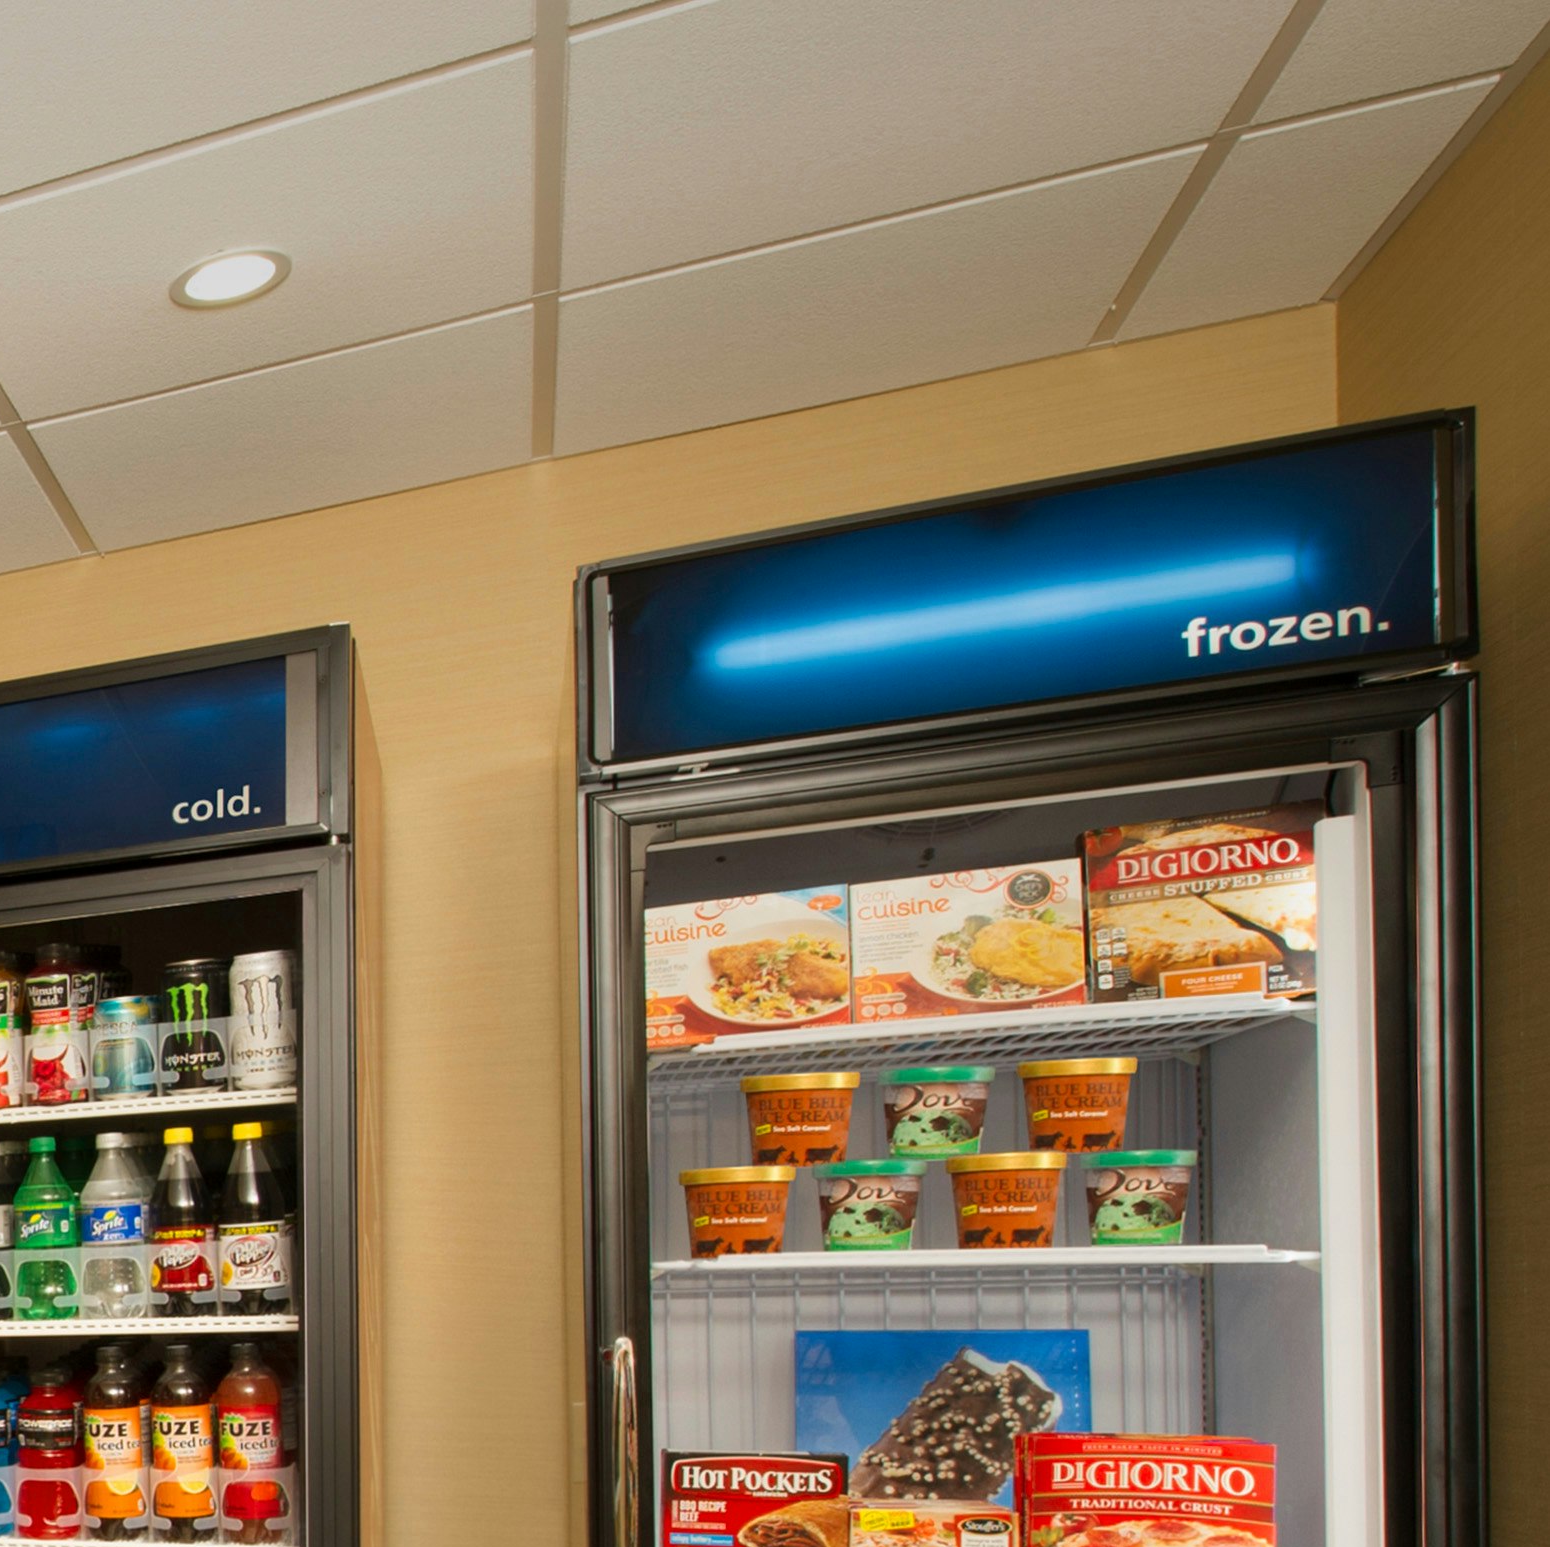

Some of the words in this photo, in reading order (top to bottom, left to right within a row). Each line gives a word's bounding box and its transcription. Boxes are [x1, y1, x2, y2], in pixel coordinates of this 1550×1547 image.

[1181, 606, 1390, 657] frozen.
[172, 786, 261, 826] cold.
[1163, 874, 1261, 897] STUFFED
[1265, 868, 1308, 882] CRUST
[857, 888, 898, 902] lean
[857, 897, 950, 920] cuisine
[645, 914, 677, 928] ean
[885, 929, 919, 940] chicken
[1181, 975, 1207, 985] FOUR
[1036, 1083, 1081, 1097] BLUE
[759, 1098, 803, 1111] BLUE
[1038, 1097, 1060, 1109] ICE
[1064, 1095, 1122, 1109] CREAM
[792, 1109, 845, 1122] CREAM
[964, 1178, 1010, 1191] BLUE
[696, 1191, 741, 1204] BLUE
[730, 1202, 782, 1215] CREAM
[19, 1218, 51, 1239] Sprite
[91, 1215, 125, 1236] Sprite
[222, 1421, 271, 1437] FUZE
[168, 1437, 196, 1451] iced
[681, 1466, 728, 1490] HOT
[730, 1467, 833, 1494] POCKETS
[1070, 1498, 1178, 1513] TRADITIONAL
[1180, 1500, 1234, 1516] CRUST
